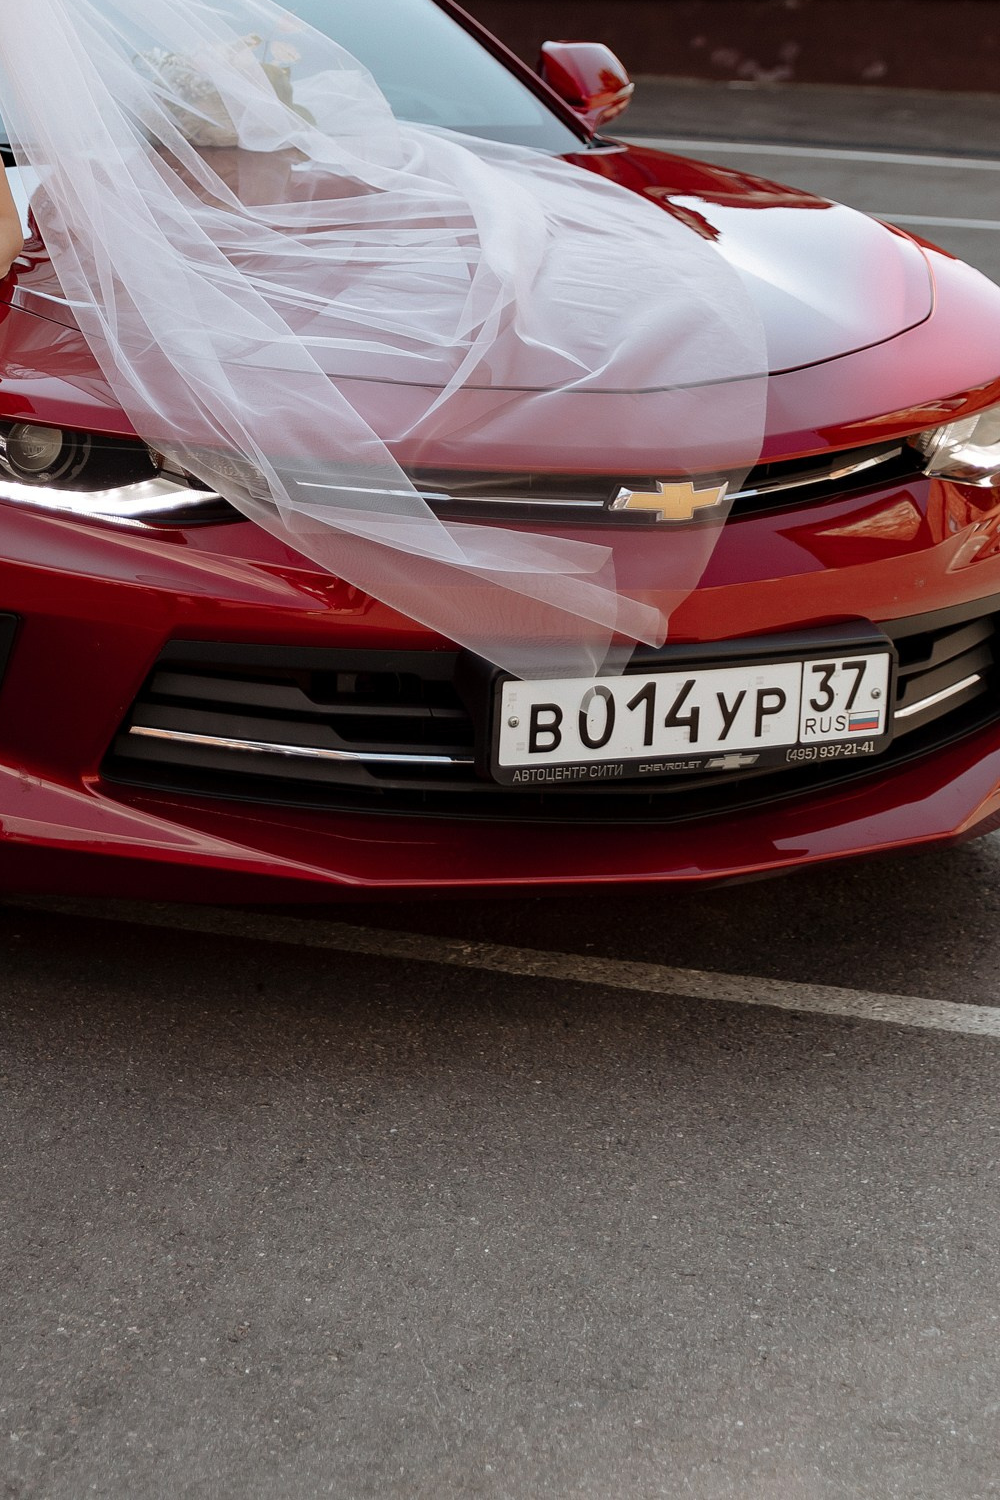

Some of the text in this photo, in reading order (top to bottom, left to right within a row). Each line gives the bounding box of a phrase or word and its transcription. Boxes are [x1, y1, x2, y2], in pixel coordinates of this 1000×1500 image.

[810, 660, 868, 713] 37
[805, 715, 846, 736] RUS
[785, 741, 875, 763] (495) 937-21-41
[512, 763, 624, 783] АВТОЦЕНТР СИТИ
[638, 761, 702, 773] CHEVROLET
